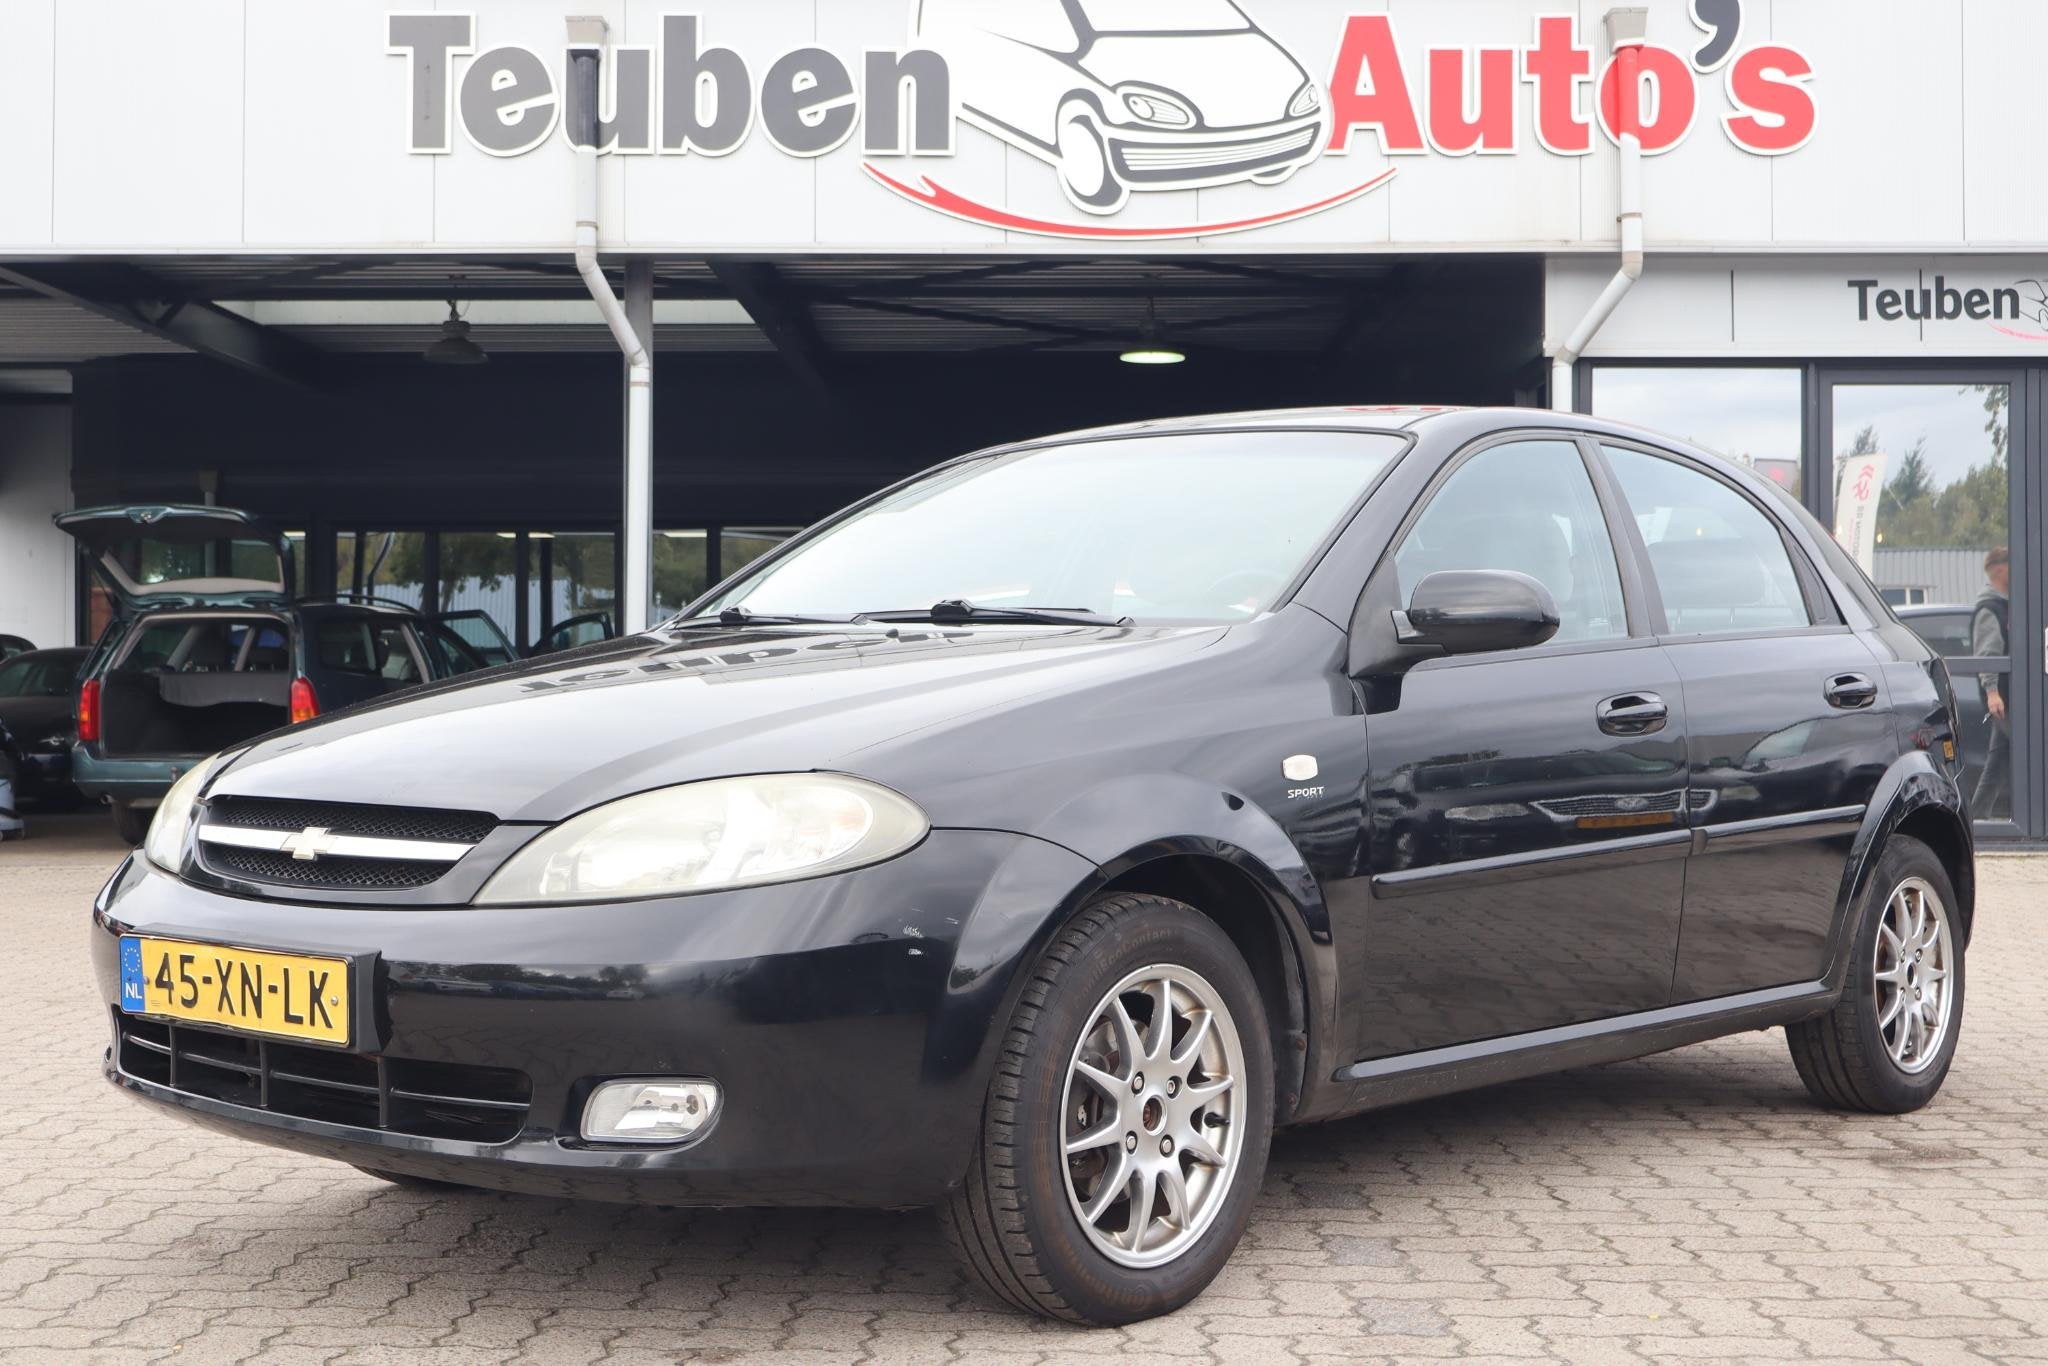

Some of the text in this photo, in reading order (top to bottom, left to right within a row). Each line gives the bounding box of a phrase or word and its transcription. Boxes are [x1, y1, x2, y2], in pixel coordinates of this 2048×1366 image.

[388, 0, 1816, 154] Teuben Auto's
[1847, 275, 2020, 321] Teuben
[1287, 786, 1325, 799] SPORT
[125, 952, 334, 1029] NL 45-XN-LK
